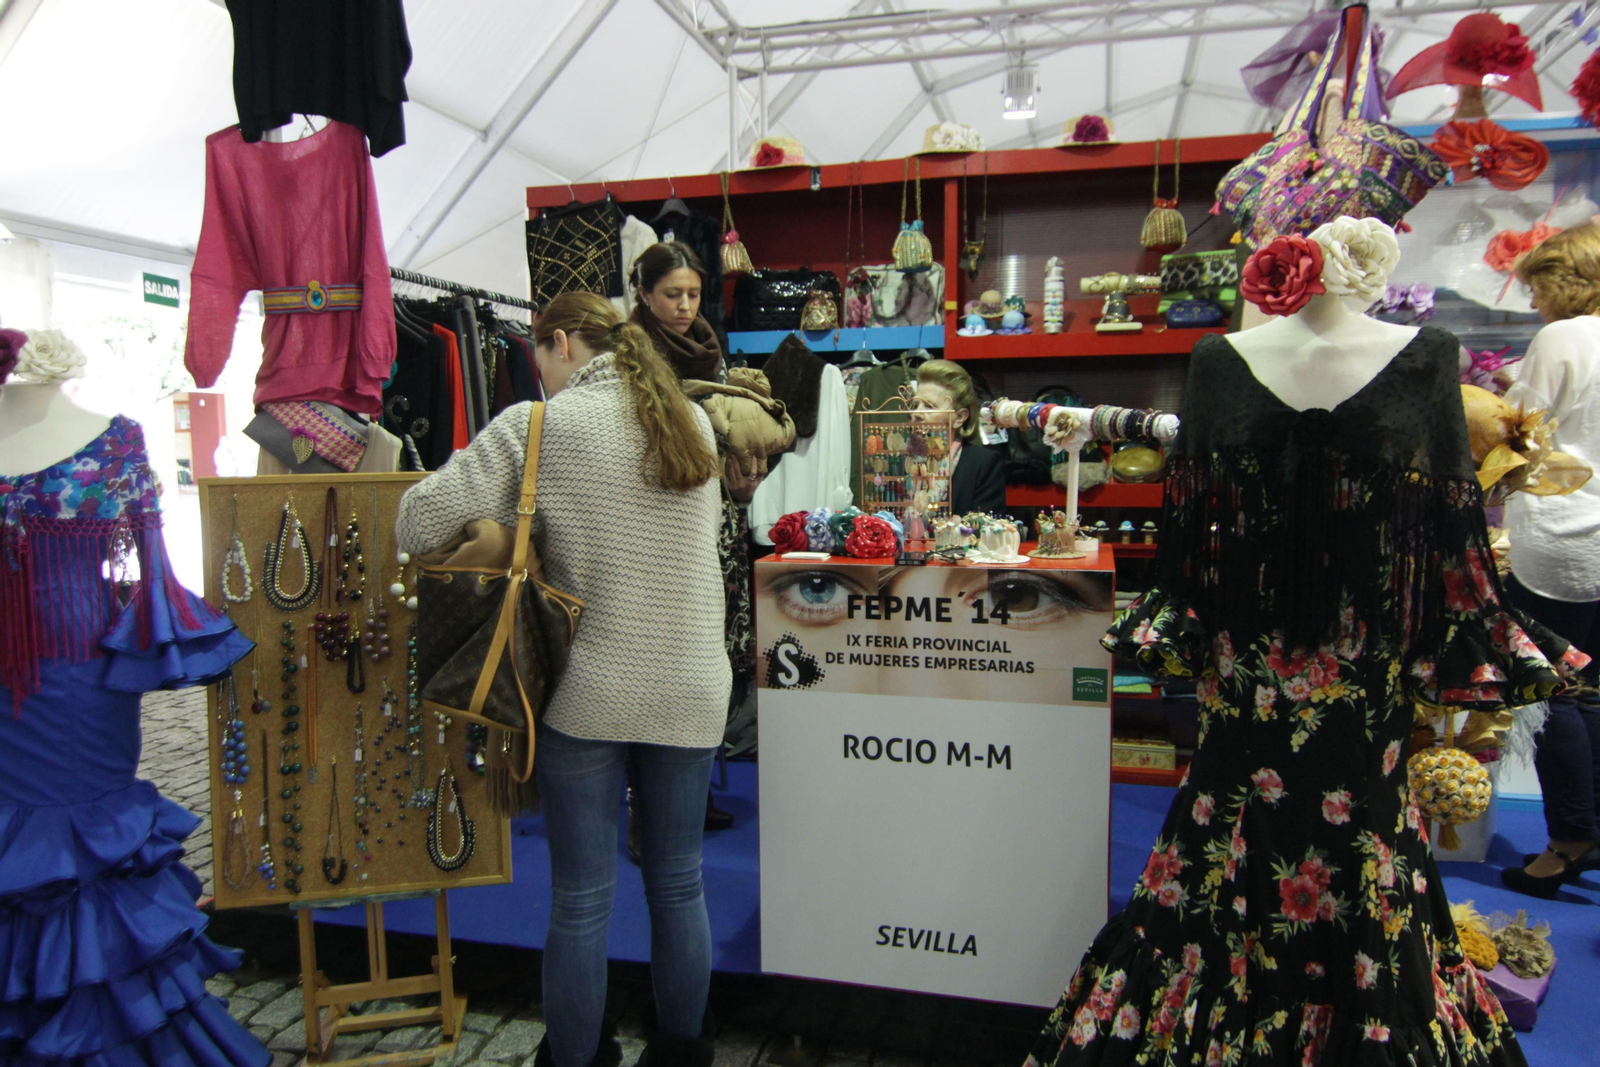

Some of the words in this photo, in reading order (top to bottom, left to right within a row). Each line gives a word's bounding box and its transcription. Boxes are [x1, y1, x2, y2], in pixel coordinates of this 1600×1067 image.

[144, 280, 179, 300] SALIDA
[846, 634, 861, 647] IX
[865, 635, 909, 650] FERIA
[912, 637, 1012, 654] PROVINCIAL
[825, 651, 845, 665] DE
[849, 652, 920, 669] MUJERES
[925, 656, 1035, 675] EMPRESARIAS
[843, 734, 937, 765] ROCIO
[947, 741, 1012, 770] M-M
[876, 924, 978, 957] SEVILLA
